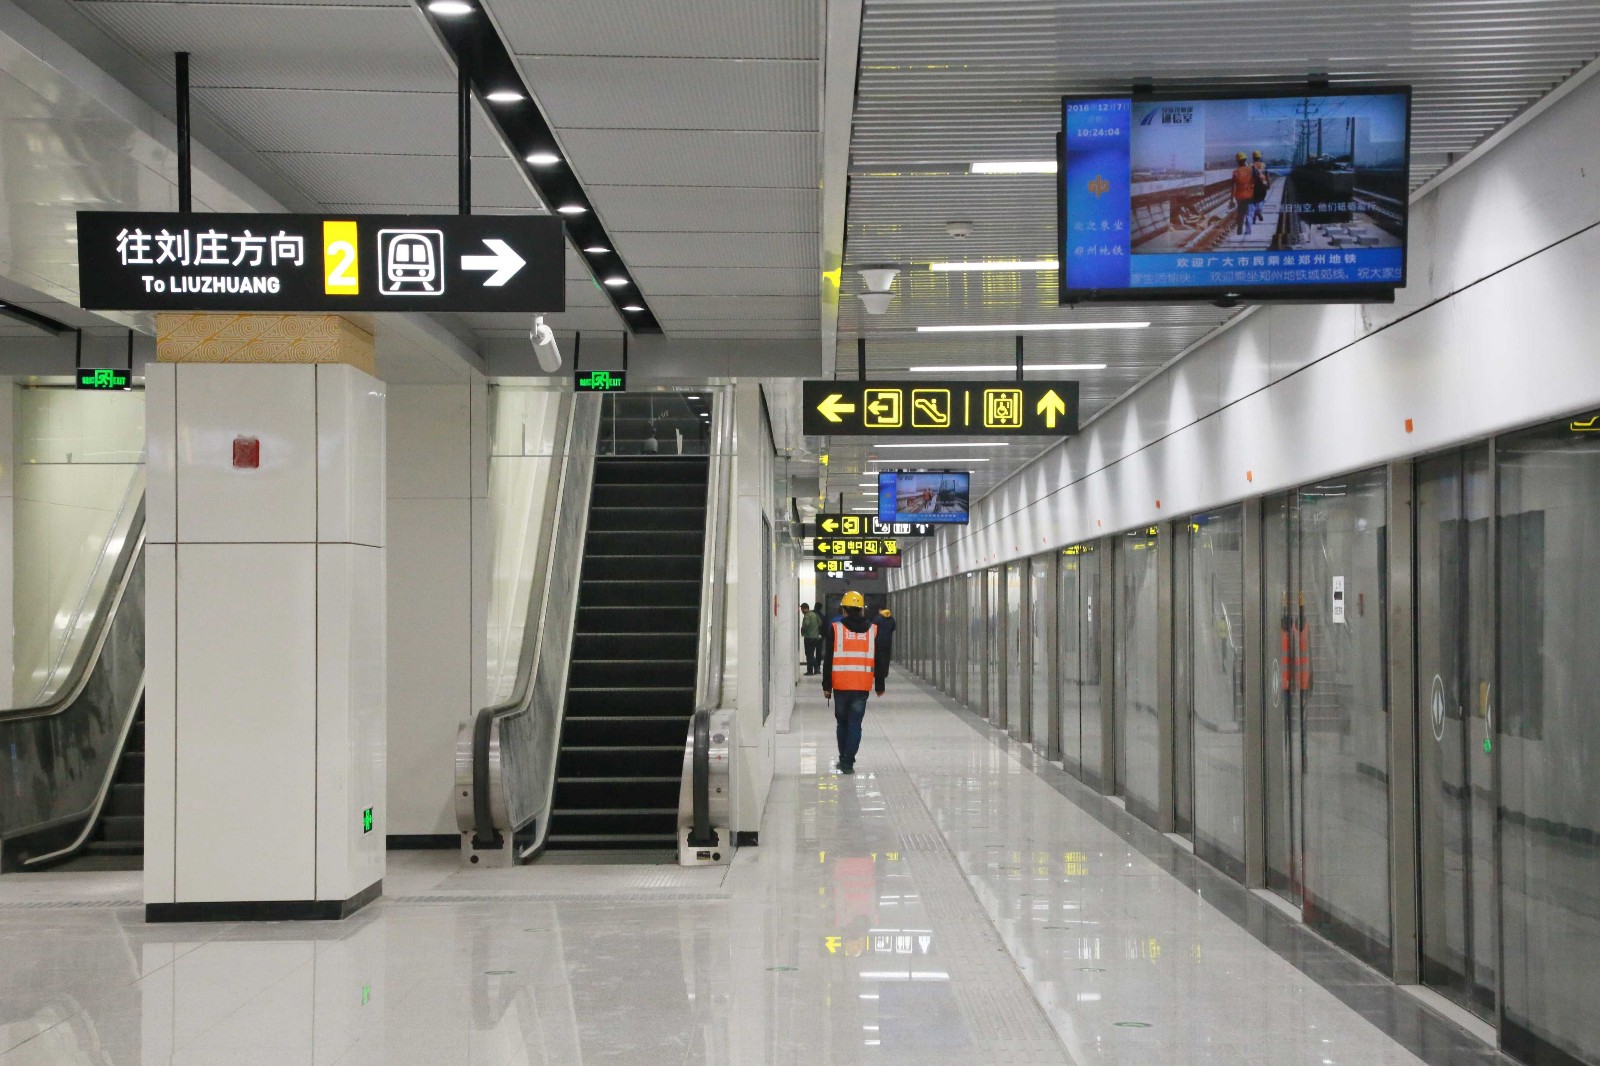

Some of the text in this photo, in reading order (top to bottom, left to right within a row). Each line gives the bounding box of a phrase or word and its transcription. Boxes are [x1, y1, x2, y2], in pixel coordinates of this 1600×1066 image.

[1077, 128, 1120, 137] 10:24:04
[115, 228, 305, 266] 往刘庄方向
[326, 240, 357, 286] 2
[1176, 253, 1358, 268] 欢迎广大市民乘坐郑州地铁
[141, 275, 281, 294] To LIUZHUANG
[847, 540, 863, 550] 出口
